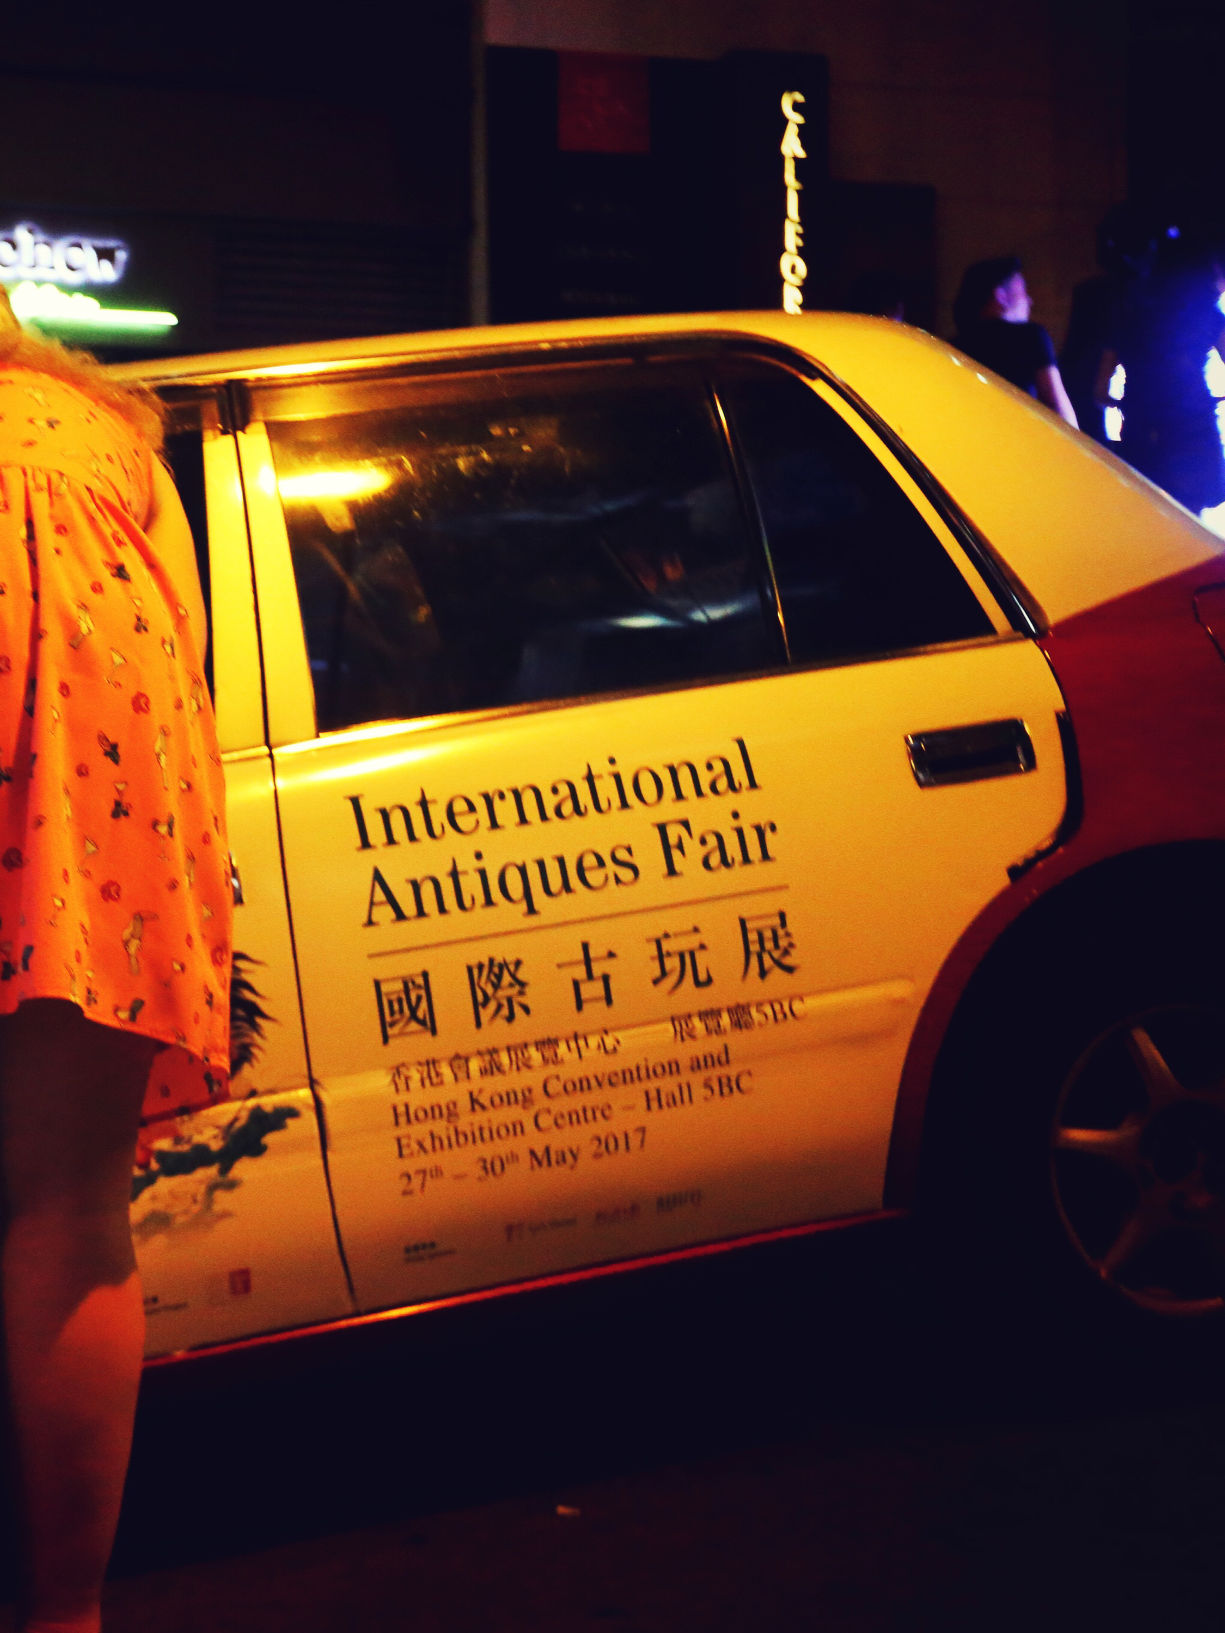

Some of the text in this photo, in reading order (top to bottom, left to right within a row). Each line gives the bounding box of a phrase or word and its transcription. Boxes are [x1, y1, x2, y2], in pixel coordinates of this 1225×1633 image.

[345, 738, 761, 850] International
[362, 810, 778, 928] Antiques Fair
[373, 910, 798, 1045] 國際古玩展
[392, 1043, 730, 1127] Hong Kong Convention and
[396, 1117, 525, 1159] Exhibition
[533, 1102, 612, 1132] Centre
[644, 1081, 693, 1112] Hall
[703, 1069, 754, 1101] 5BC
[528, 1144, 580, 1171] May
[591, 1126, 647, 1160] 2017
